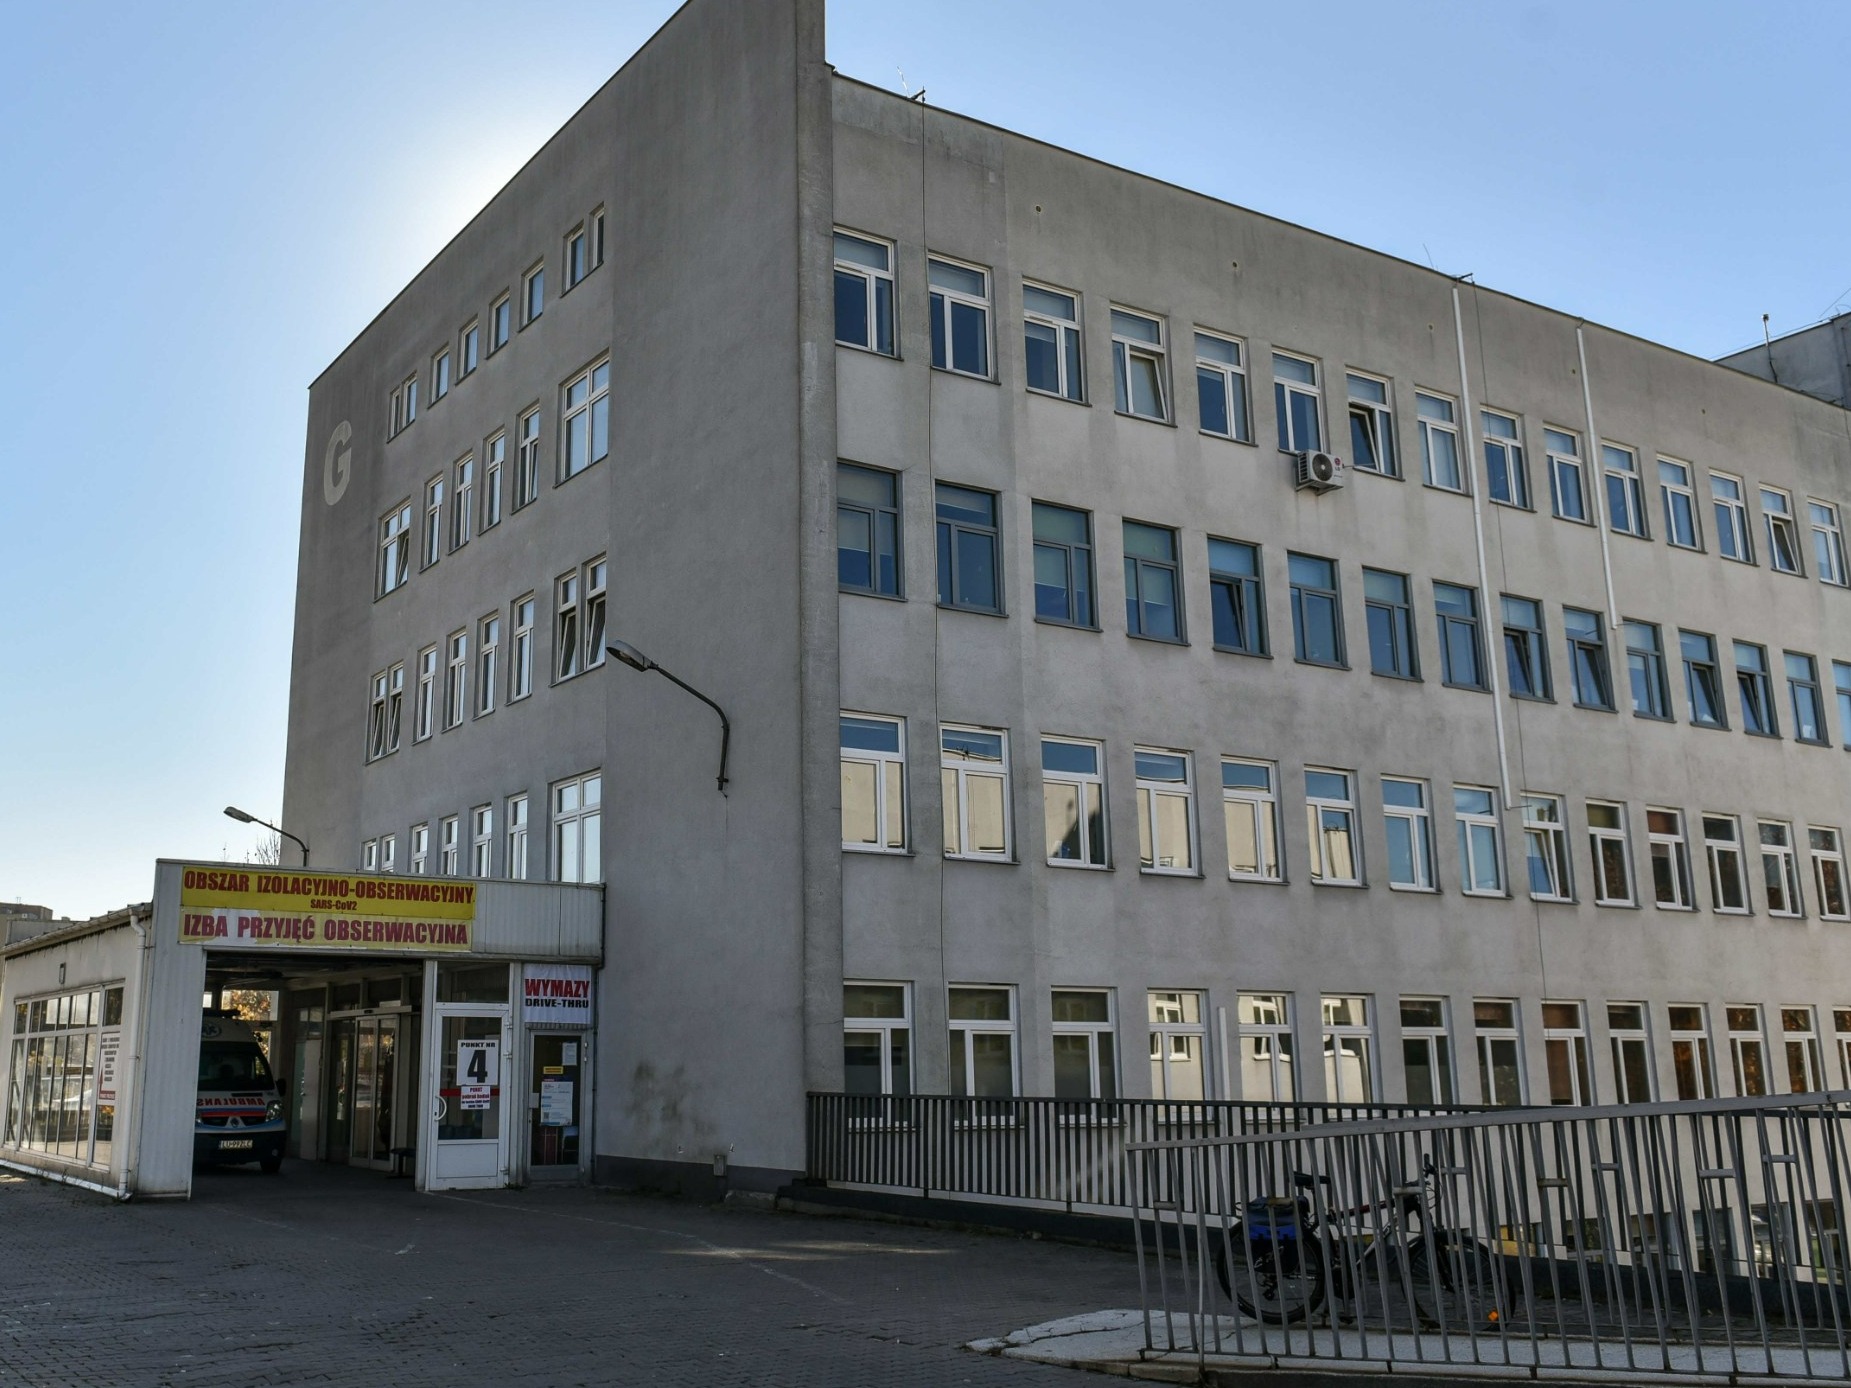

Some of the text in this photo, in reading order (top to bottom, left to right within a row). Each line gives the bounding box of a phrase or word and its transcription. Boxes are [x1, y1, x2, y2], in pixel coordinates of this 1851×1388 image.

[323, 419, 352, 506] G
[184, 870, 474, 904] OBSZAR IZOLACYJNO-OBSERWACYJNY
[310, 898, 358, 910] SARS-CoV2
[183, 914, 468, 945] IZBA PRZYJĘĆ OBSERWACYJNA
[524, 978, 590, 998] WYMAZY
[525, 998, 589, 1008] DRIVE-THRU
[467, 1049, 488, 1084] 4
